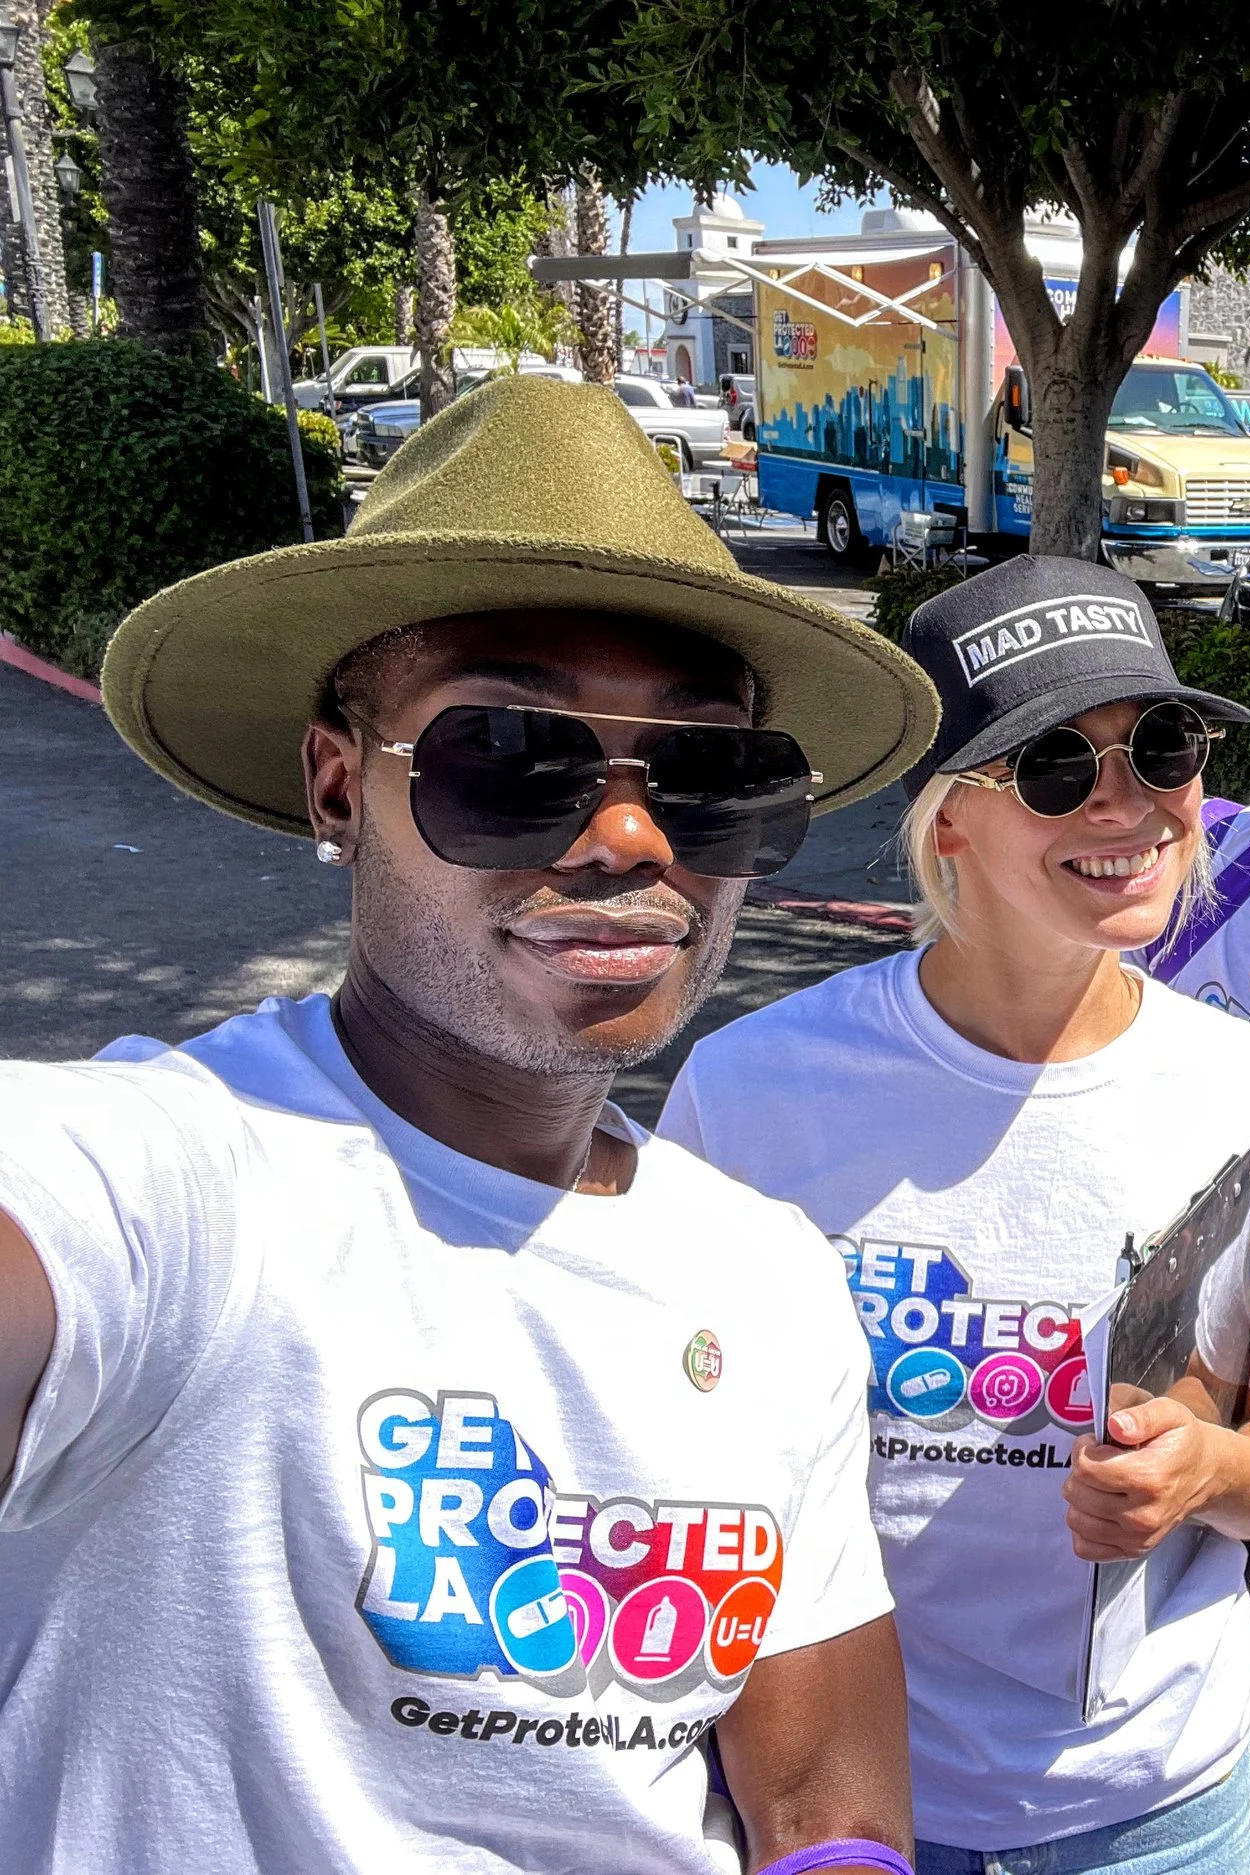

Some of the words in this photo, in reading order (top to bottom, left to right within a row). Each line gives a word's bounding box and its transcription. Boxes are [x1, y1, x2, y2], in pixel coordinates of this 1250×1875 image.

[966, 617, 1042, 671] MAD
[1046, 604, 1140, 634] TASTY
[850, 1291, 1083, 1352] ROTEC
[363, 1472, 778, 1573] PROECTED
[362, 1546, 484, 1625] LA
